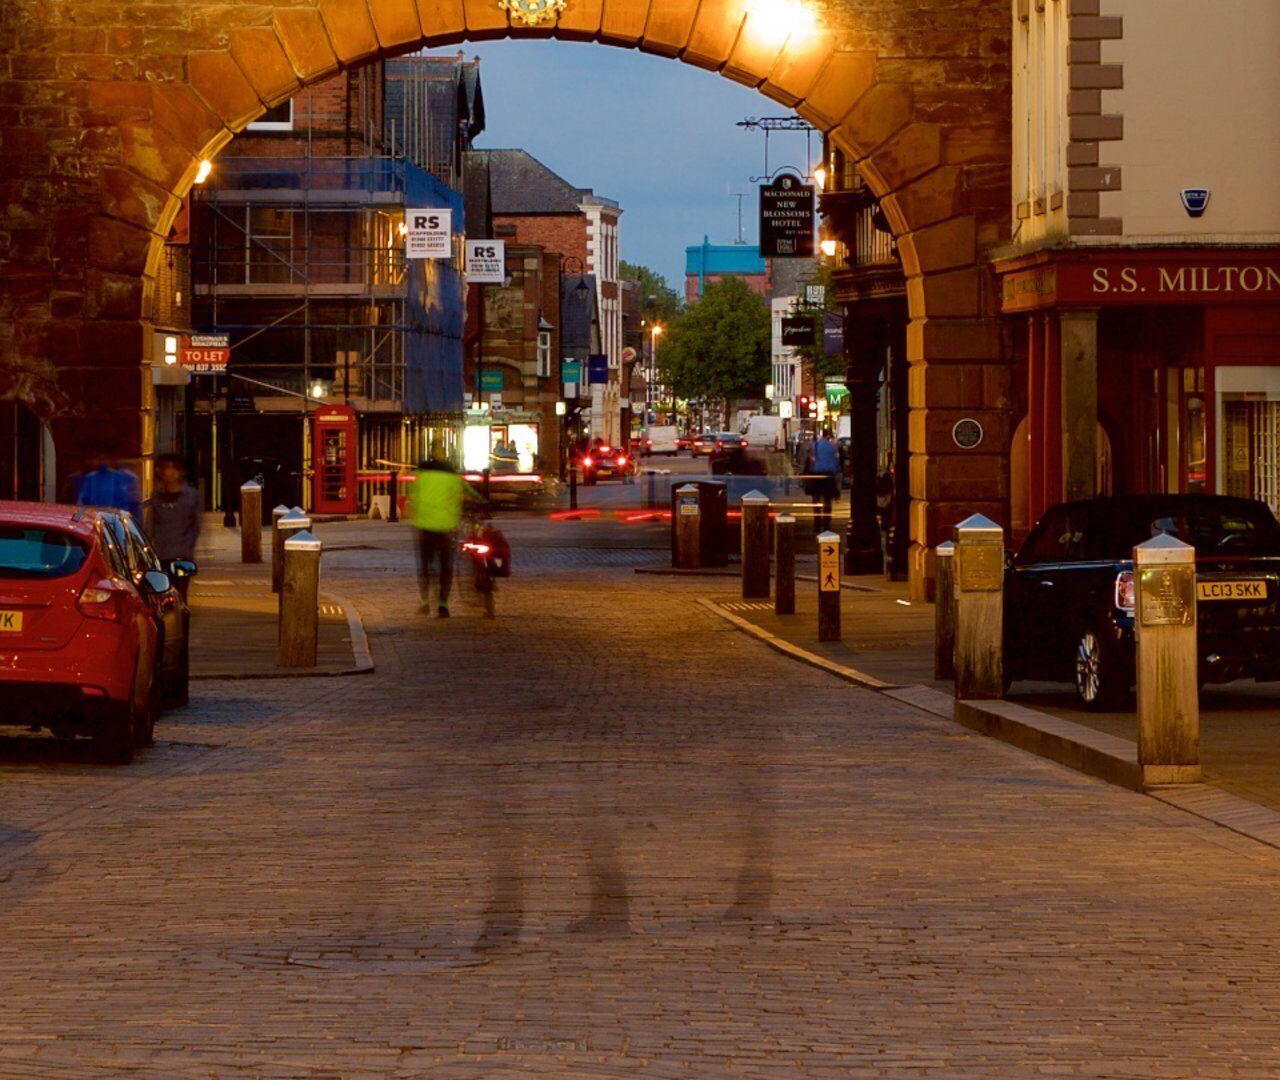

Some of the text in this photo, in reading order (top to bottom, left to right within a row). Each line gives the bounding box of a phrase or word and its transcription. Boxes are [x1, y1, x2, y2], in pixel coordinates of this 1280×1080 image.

[763, 210, 810, 218] BLOSSOMS
[414, 216, 440, 229] RS
[474, 247, 495, 258] RS
[1092, 267, 1146, 292] S.S.
[185, 351, 224, 361] TO LET
[1202, 583, 1261, 598] LC13 SKK
